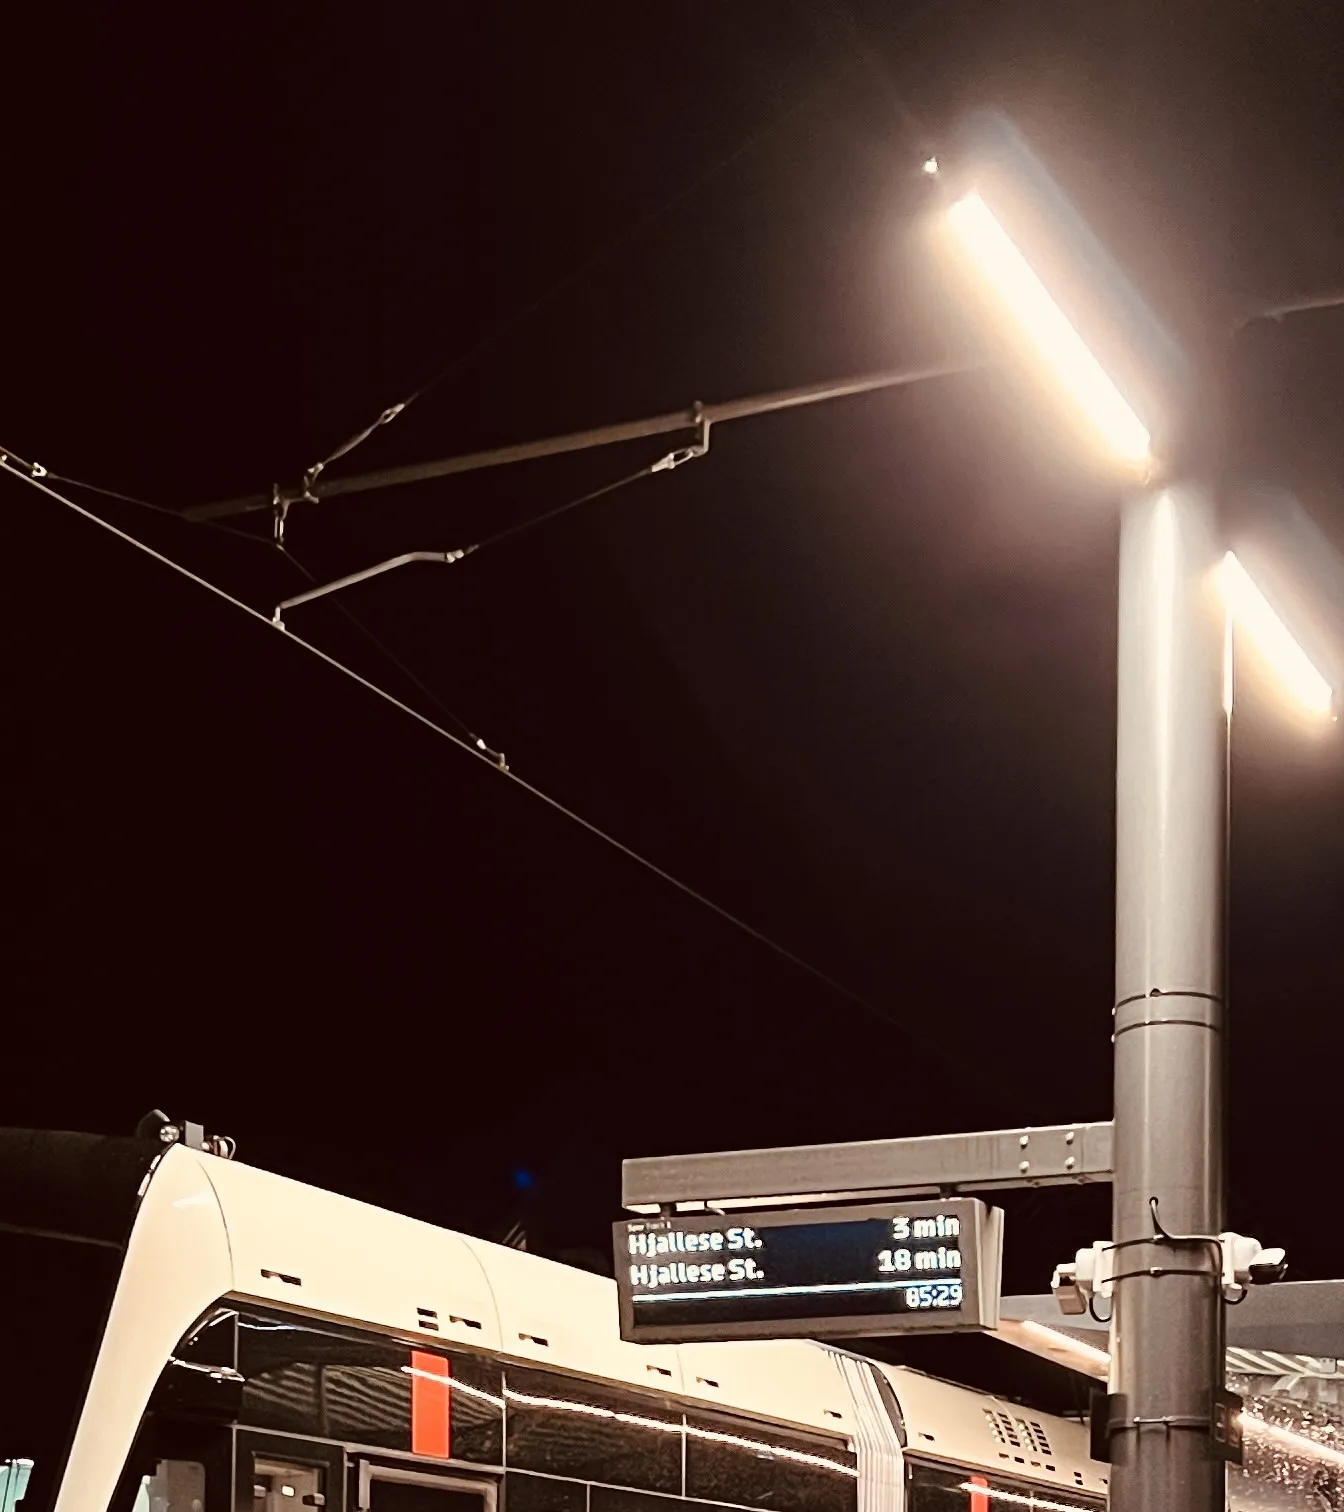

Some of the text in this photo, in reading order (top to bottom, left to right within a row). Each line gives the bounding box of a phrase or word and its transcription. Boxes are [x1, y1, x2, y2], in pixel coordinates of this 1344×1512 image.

[628, 1214, 960, 1257] Hjallese St. 3 min
[630, 1246, 962, 1289] Hjallese St. 18 min
[905, 1285, 963, 1309] 05:29
